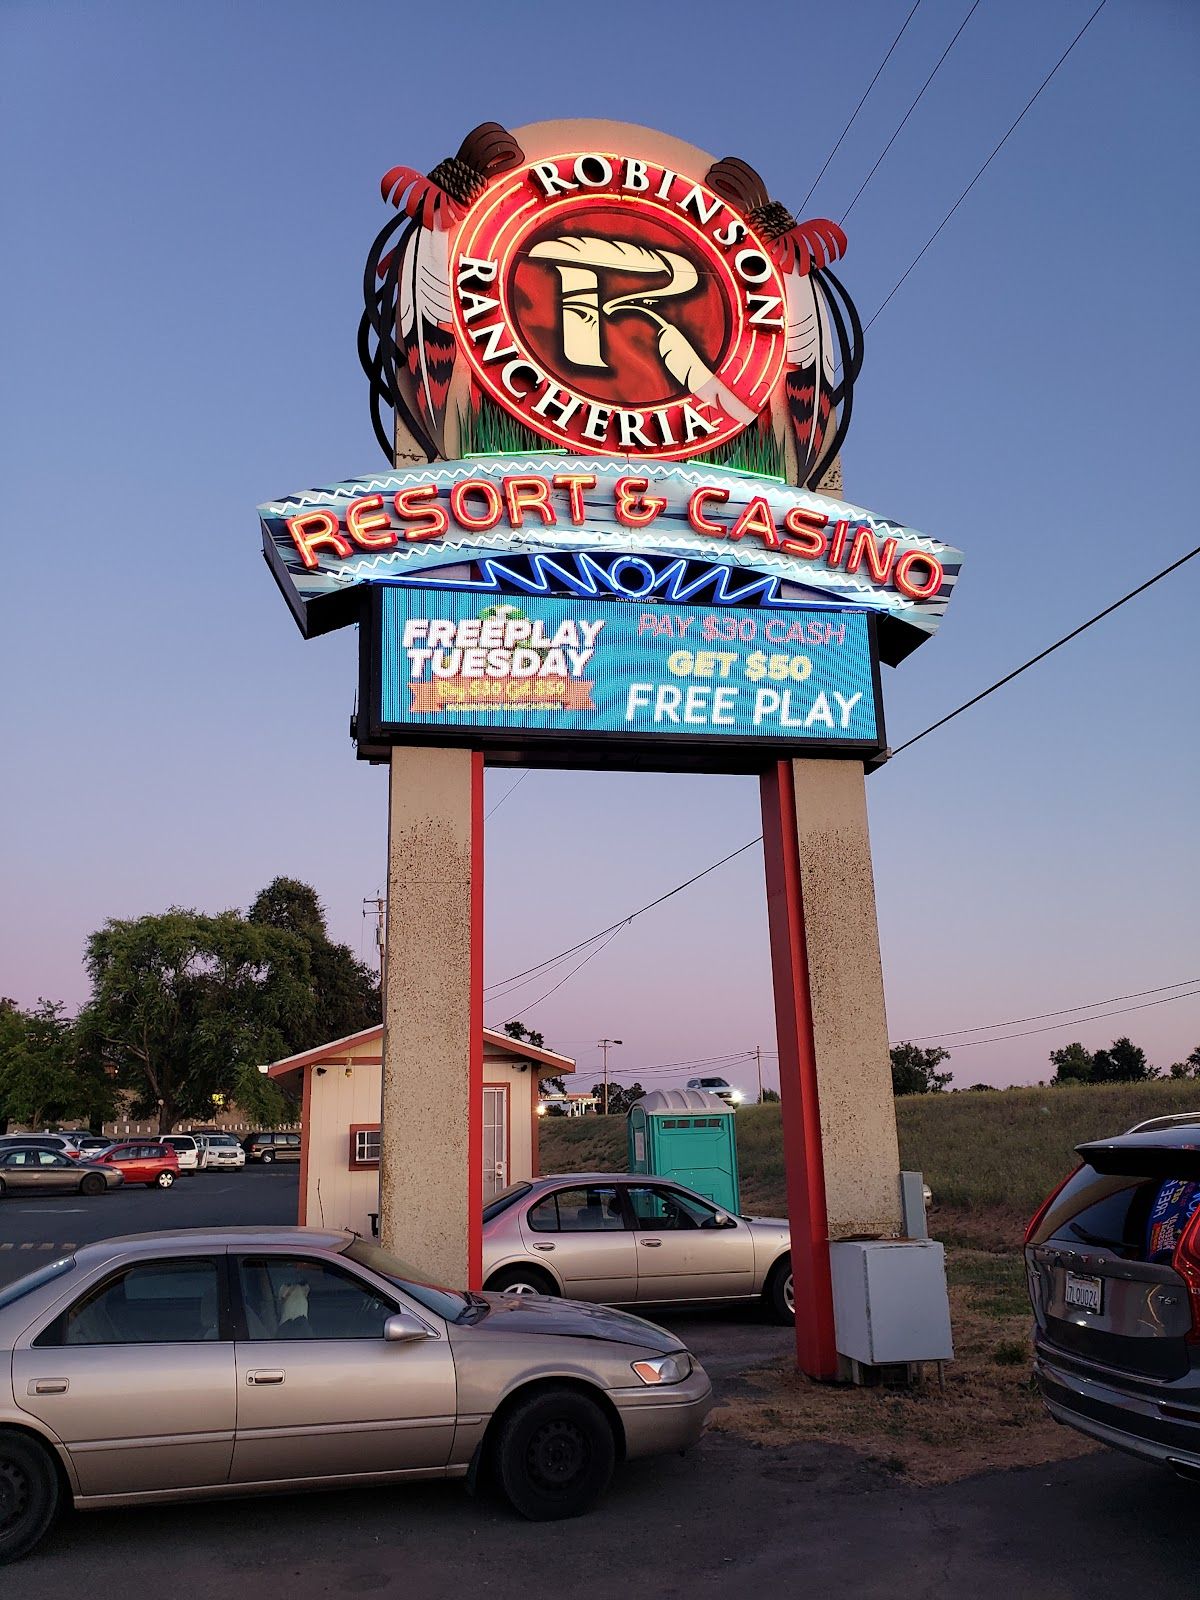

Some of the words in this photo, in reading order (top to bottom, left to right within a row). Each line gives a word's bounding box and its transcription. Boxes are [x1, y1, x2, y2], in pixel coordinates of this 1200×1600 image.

[534, 155, 785, 328] ROBINSON
[458, 255, 722, 447] RANCHERIA
[286, 474, 597, 570] RESORT
[615, 476, 667, 528] &
[687, 486, 944, 600] CASINO
[403, 618, 606, 649] FREEPLAY
[637, 613, 695, 638] PAY
[702, 614, 757, 642] $30
[765, 619, 846, 646] CASH
[407, 648, 595, 678] TUESDAY
[667, 650, 738, 678] GET
[745, 650, 813, 682] $50
[625, 682, 739, 725] FREE
[752, 687, 863, 729] PLAY
